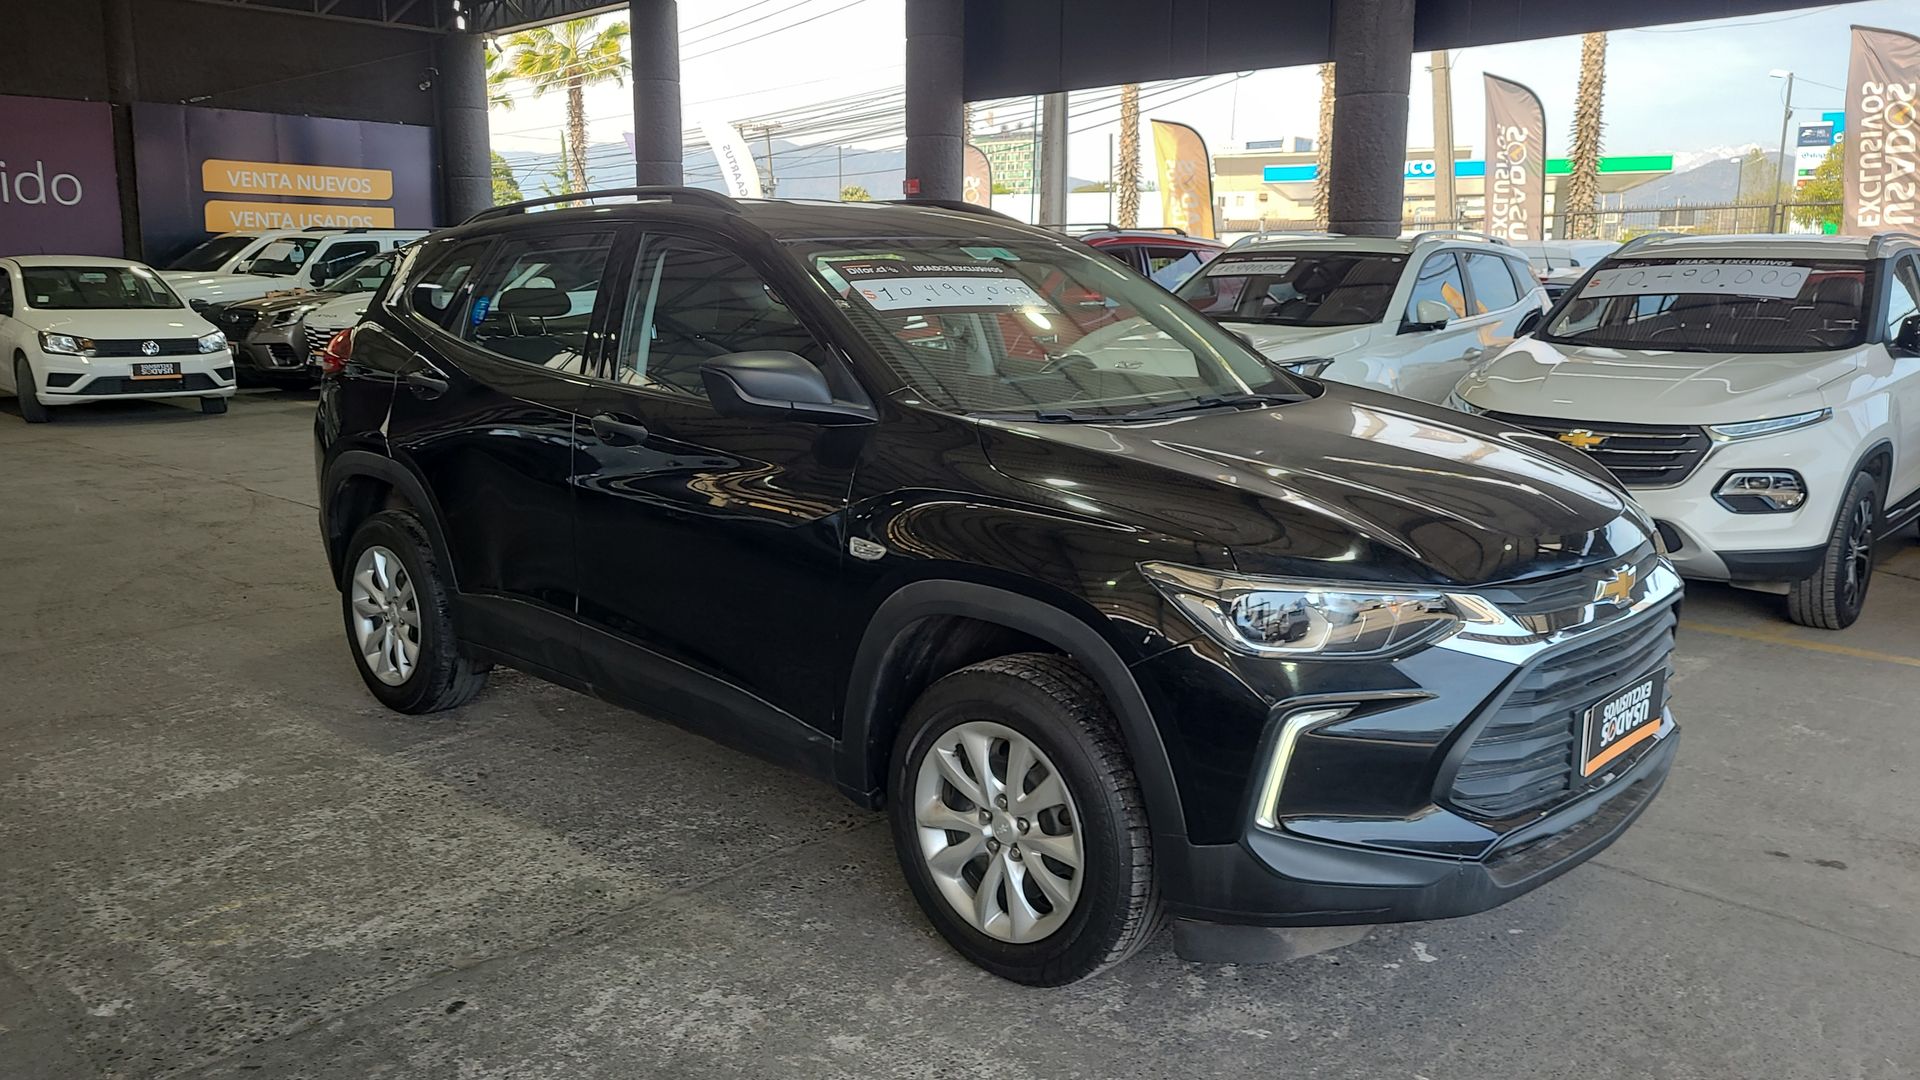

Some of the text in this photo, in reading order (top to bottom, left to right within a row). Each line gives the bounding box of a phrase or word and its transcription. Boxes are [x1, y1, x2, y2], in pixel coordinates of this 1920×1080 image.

[226, 170, 372, 194] VENTA NUEVOS
[229, 210, 374, 229] VENTA USADOS
[1723, 259, 1793, 268] EXCLUSIVOS
[1602, 680, 1654, 724] EXCLUSIVOS
[1600, 698, 1650, 748] USADOS
